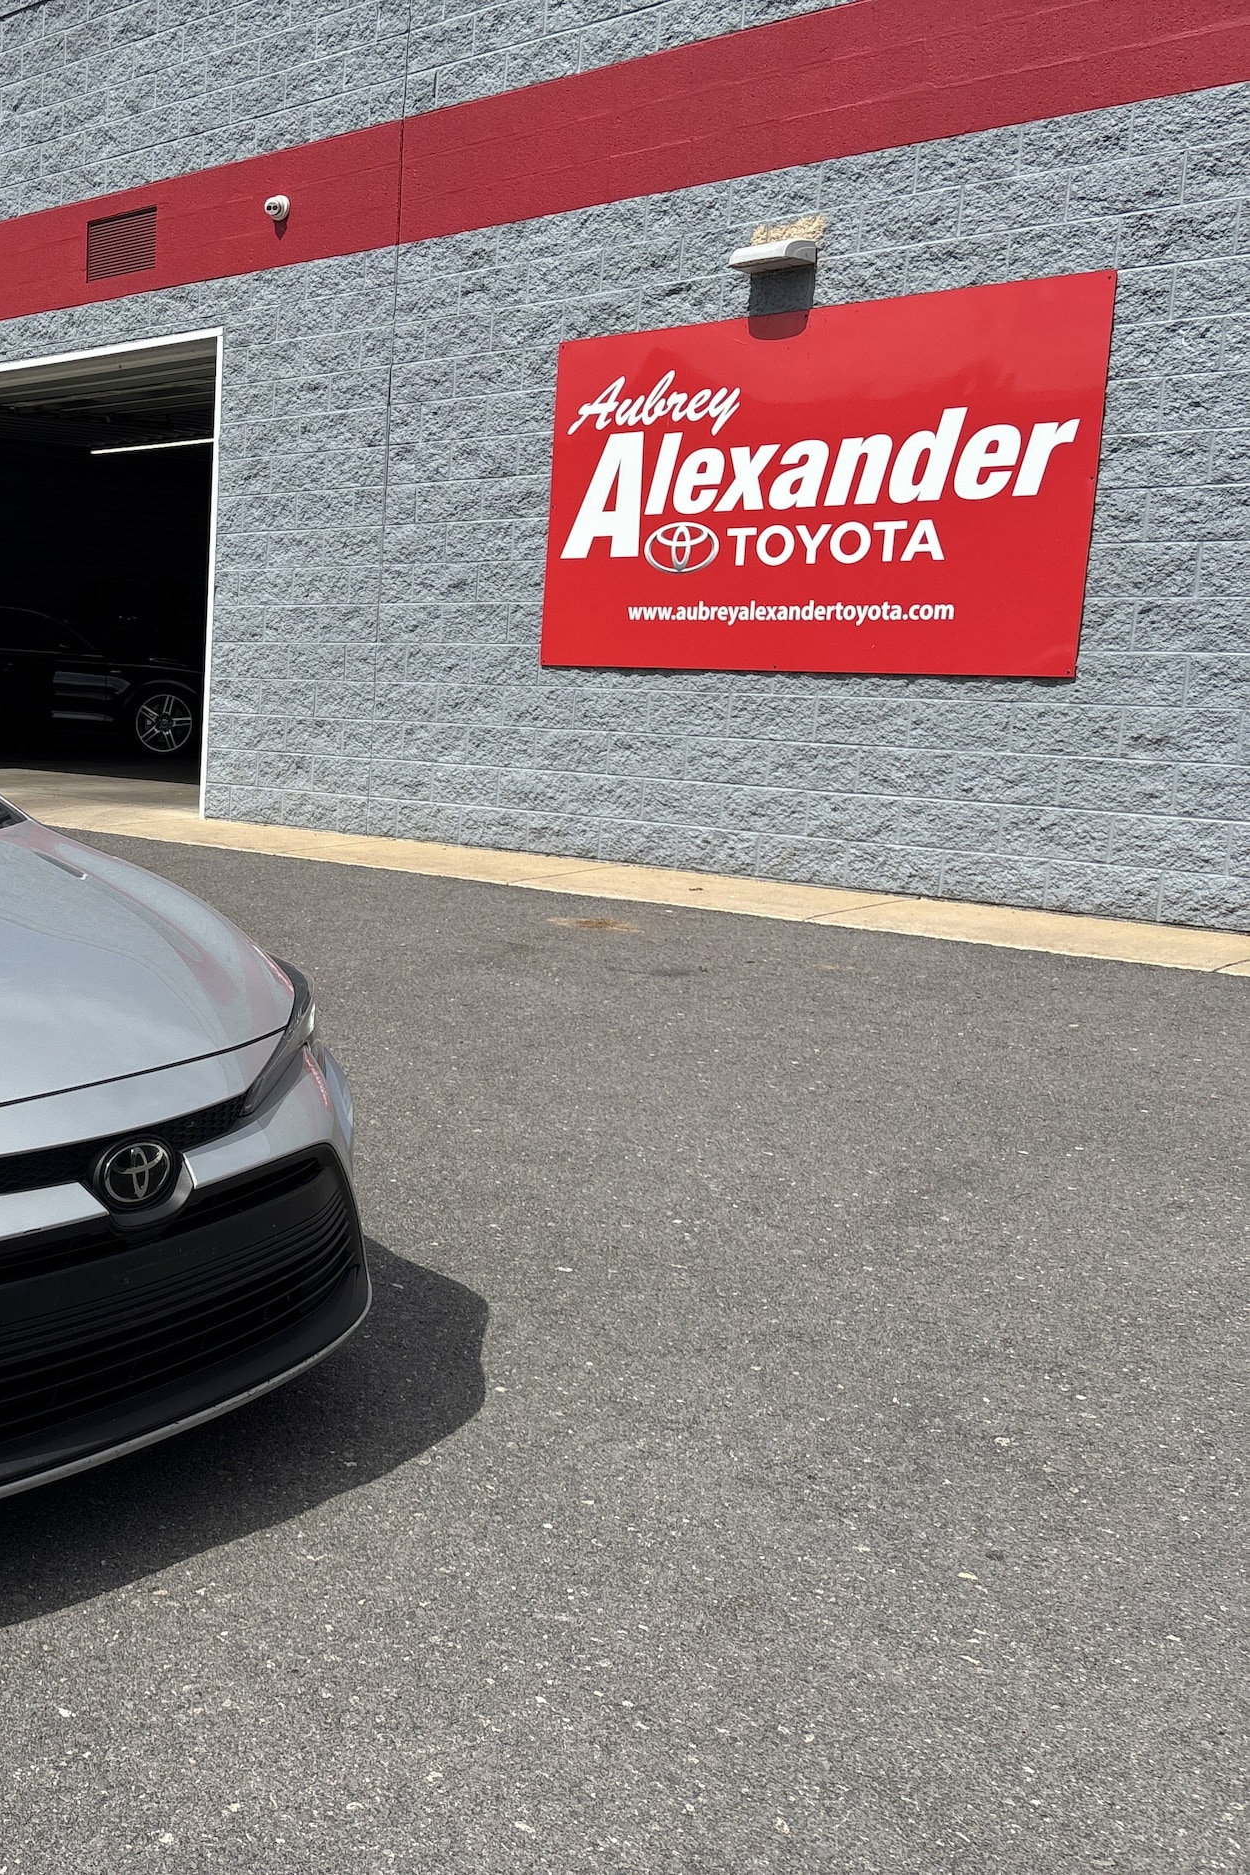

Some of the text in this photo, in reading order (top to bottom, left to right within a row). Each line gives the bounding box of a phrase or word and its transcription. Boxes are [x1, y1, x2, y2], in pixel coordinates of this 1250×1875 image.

[567, 369, 741, 436] Aubrey
[560, 406, 1081, 560] Alexander
[726, 519, 946, 567] TOYOTA
[627, 599, 955, 627] www.aubreyalexandertoyota.com
